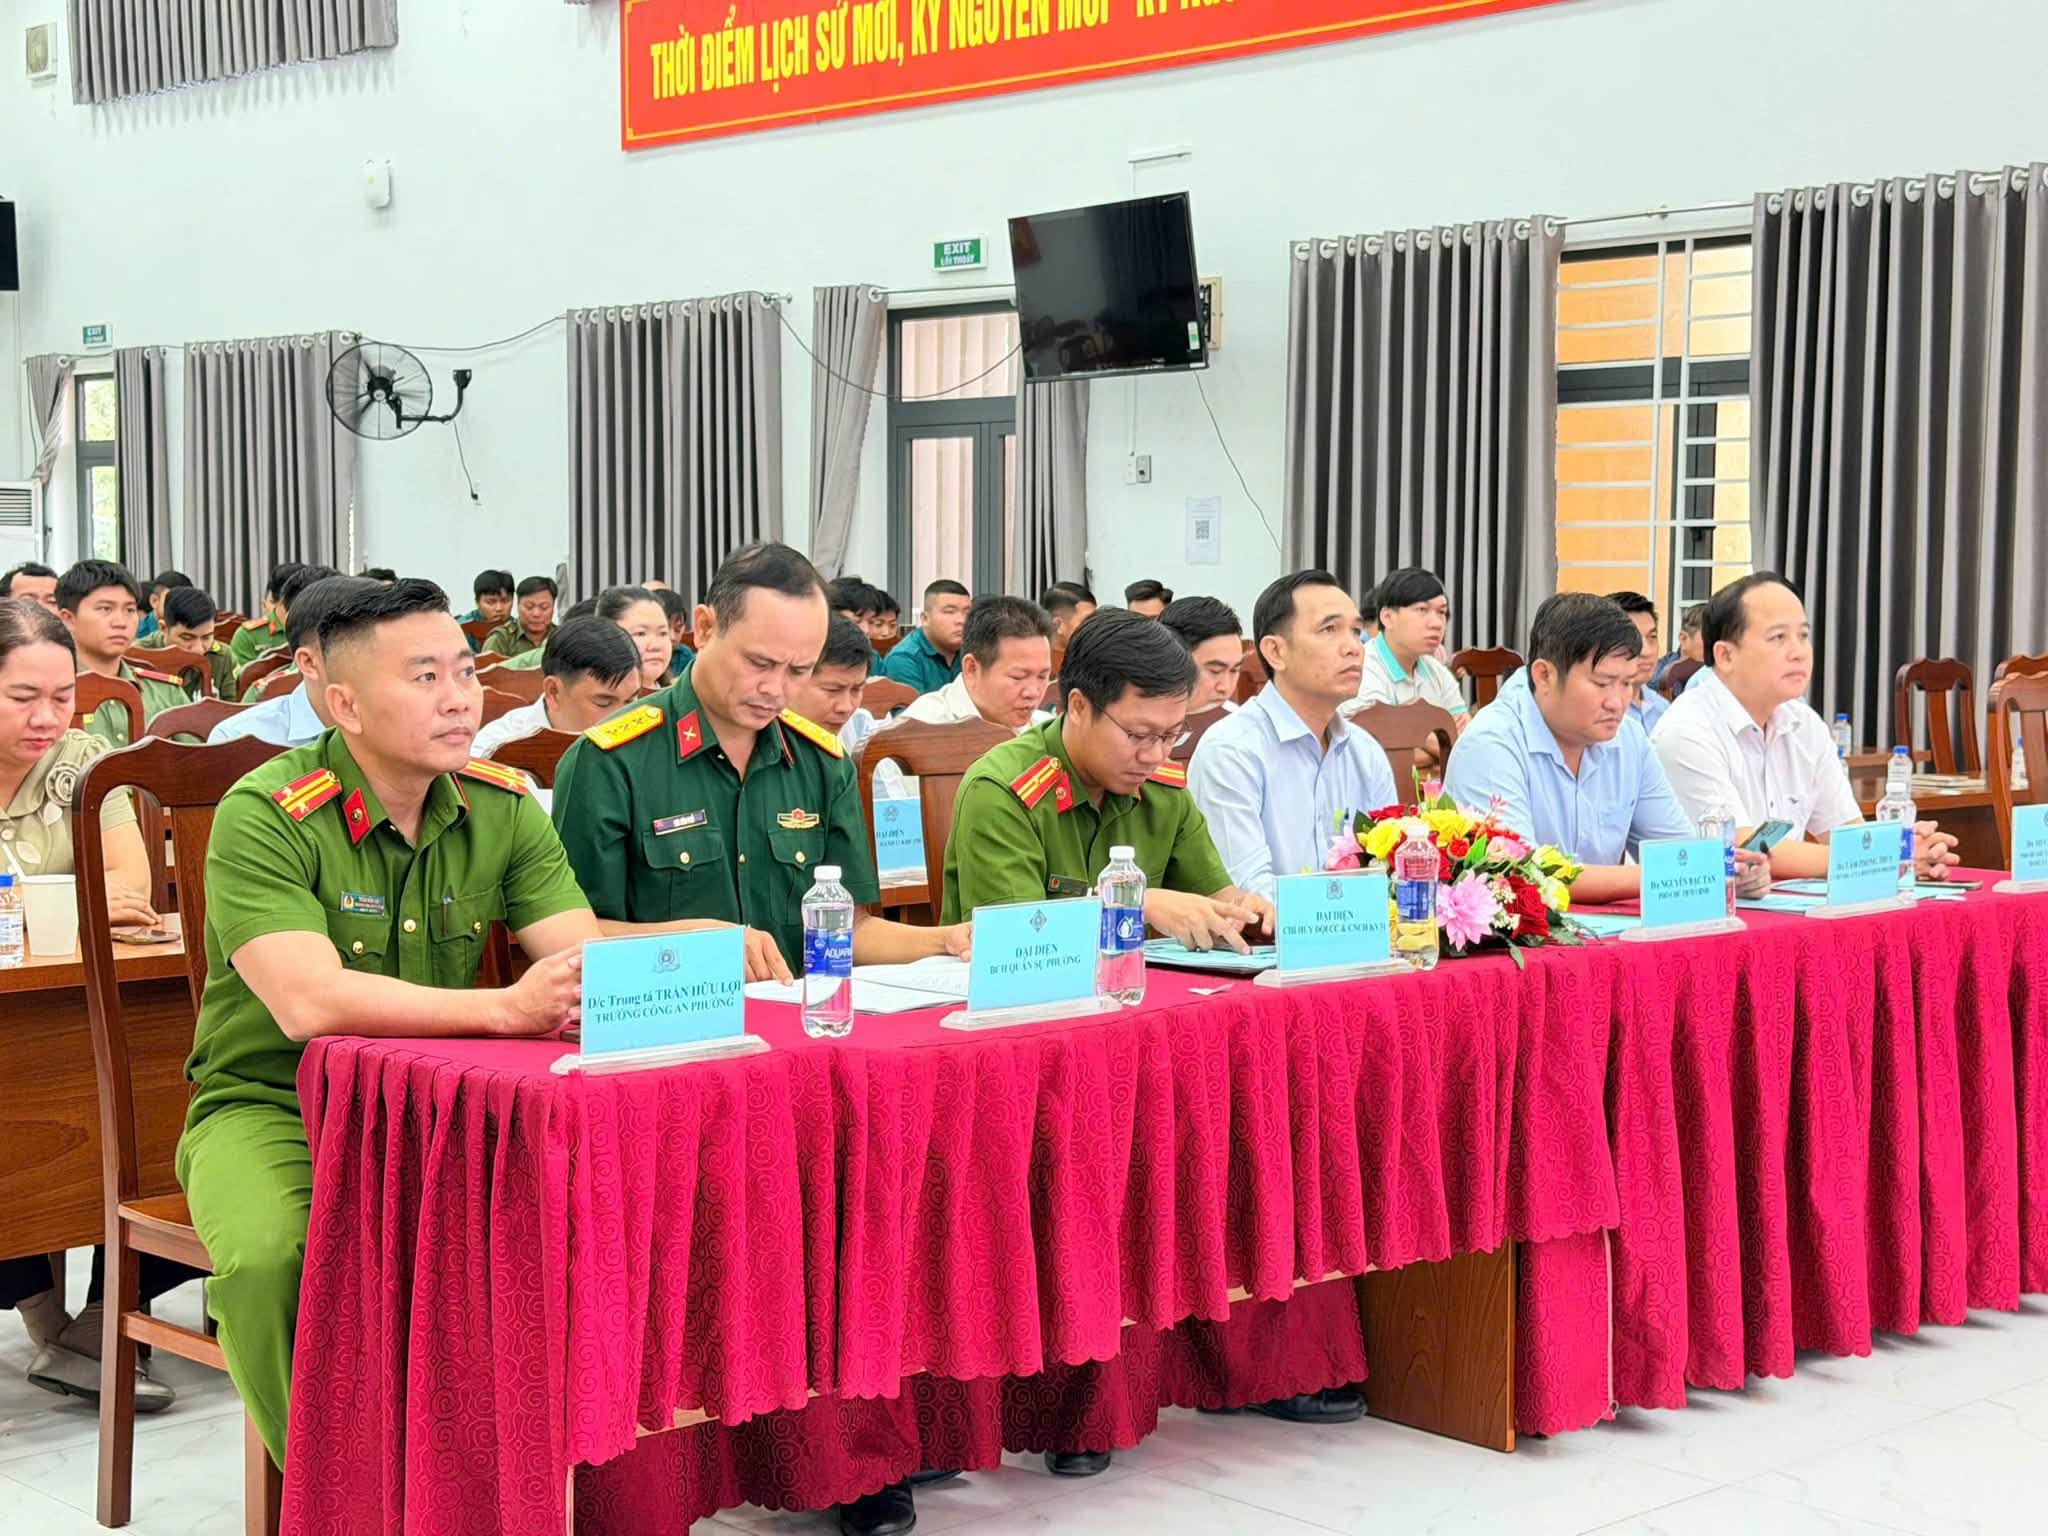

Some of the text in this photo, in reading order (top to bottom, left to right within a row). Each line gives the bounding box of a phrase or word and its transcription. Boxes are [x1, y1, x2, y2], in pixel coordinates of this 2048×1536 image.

[651, 24, 696, 99] THỜI
[701, 4, 754, 91] ĐIỂM
[761, 15, 809, 93] LỊCH
[944, 241, 971, 255] EXIT
[608, 993, 640, 1006] Trung
[643, 990, 653, 1002] tá
[643, 1003, 673, 1018] CÔNG
[674, 1001, 689, 1014] AN
